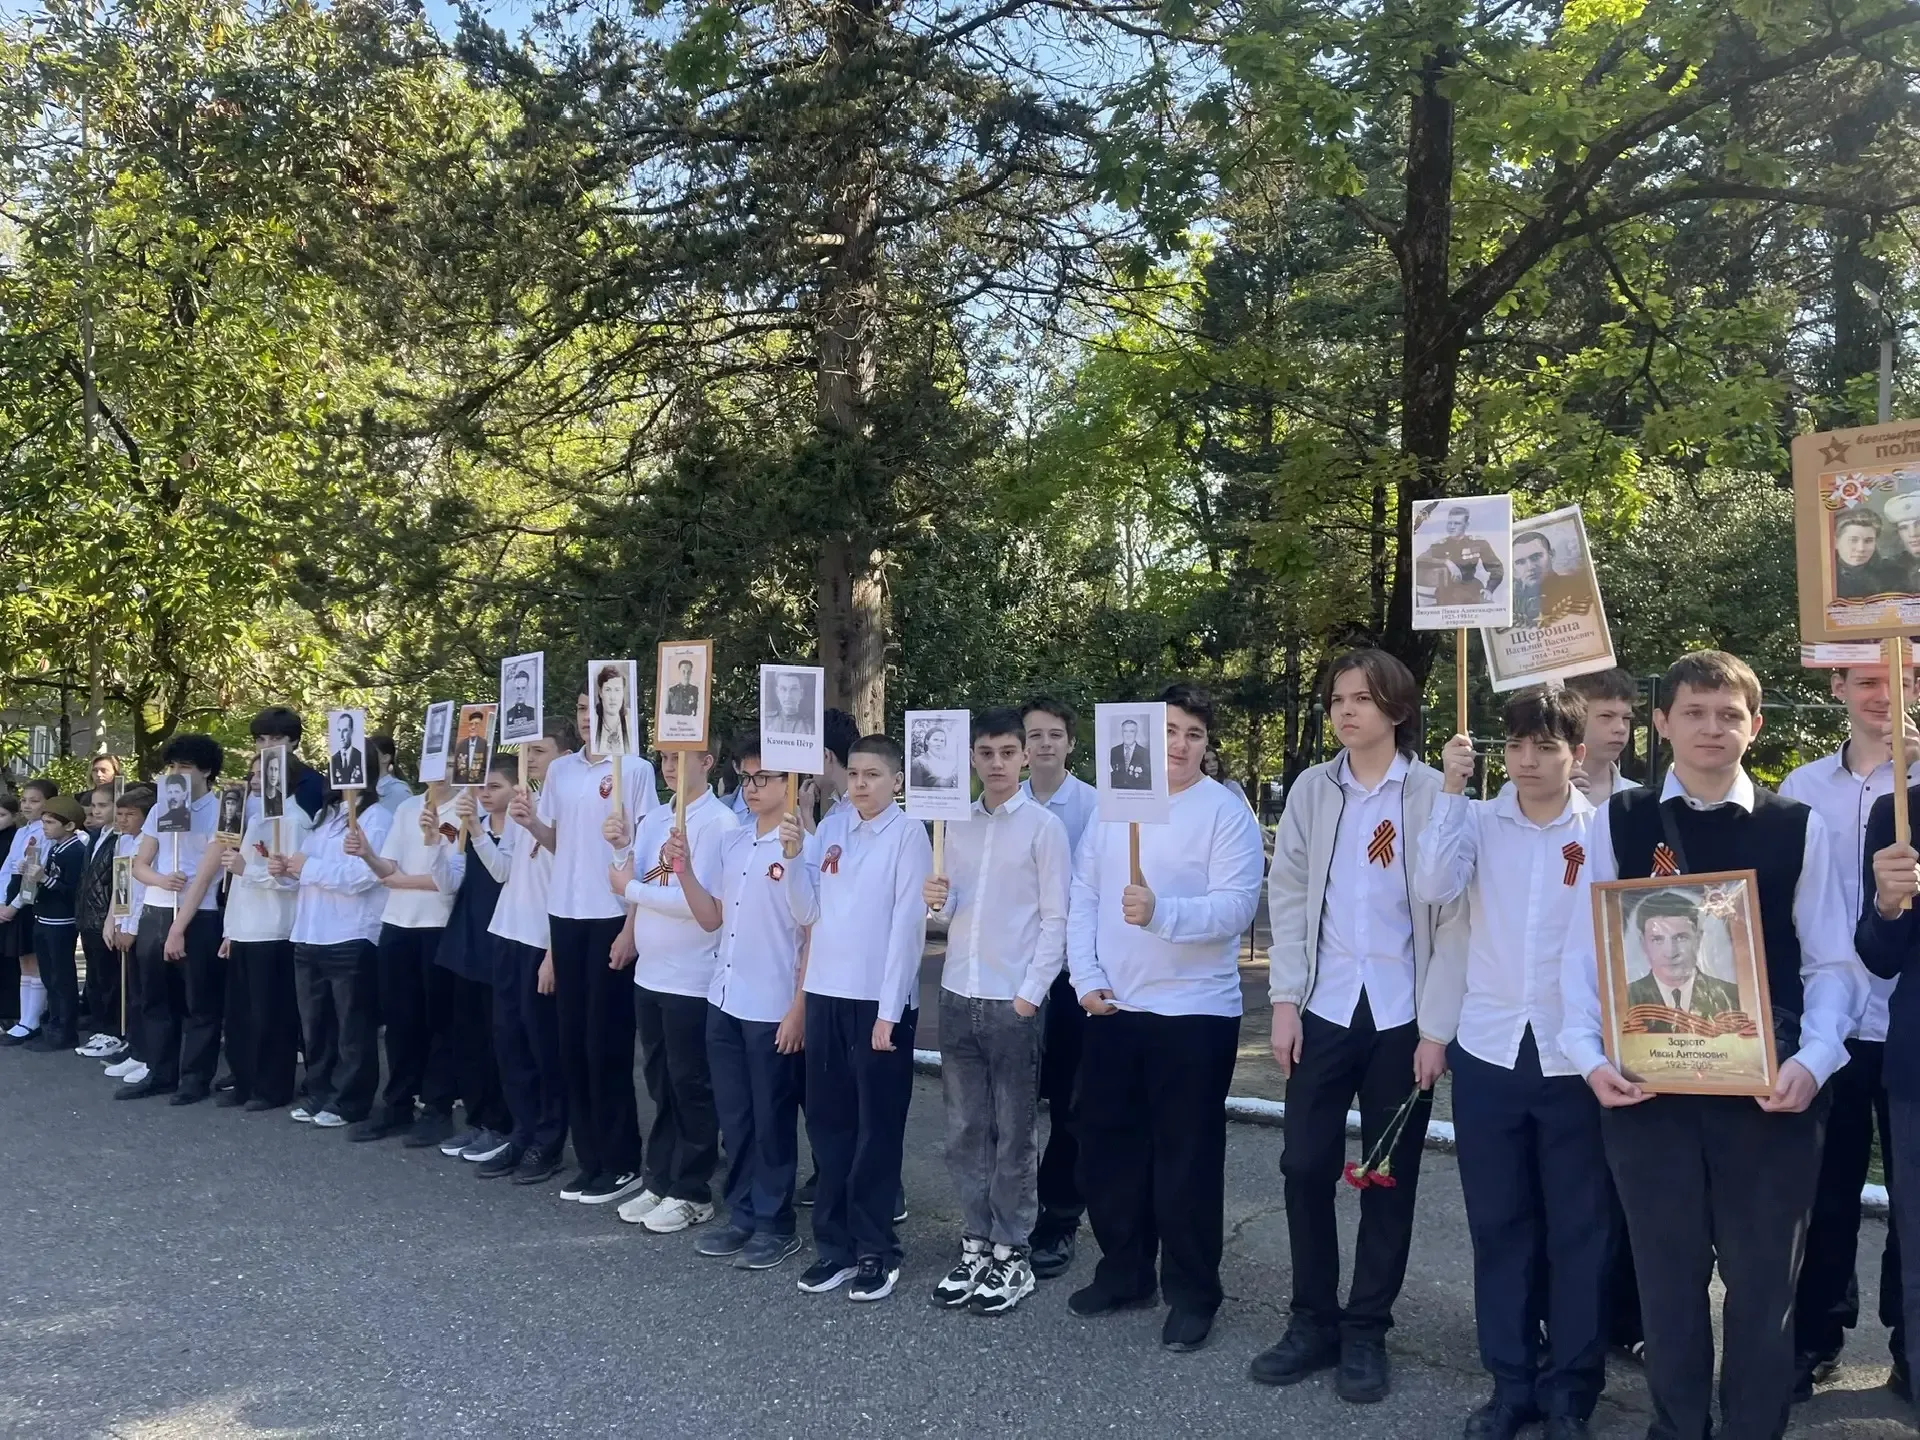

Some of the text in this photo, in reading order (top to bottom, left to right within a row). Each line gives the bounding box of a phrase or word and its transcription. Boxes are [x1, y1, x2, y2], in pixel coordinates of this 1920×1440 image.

[1544, 631, 1595, 647] Васильевич
[1649, 1049, 1728, 1059] Иван Антонович
